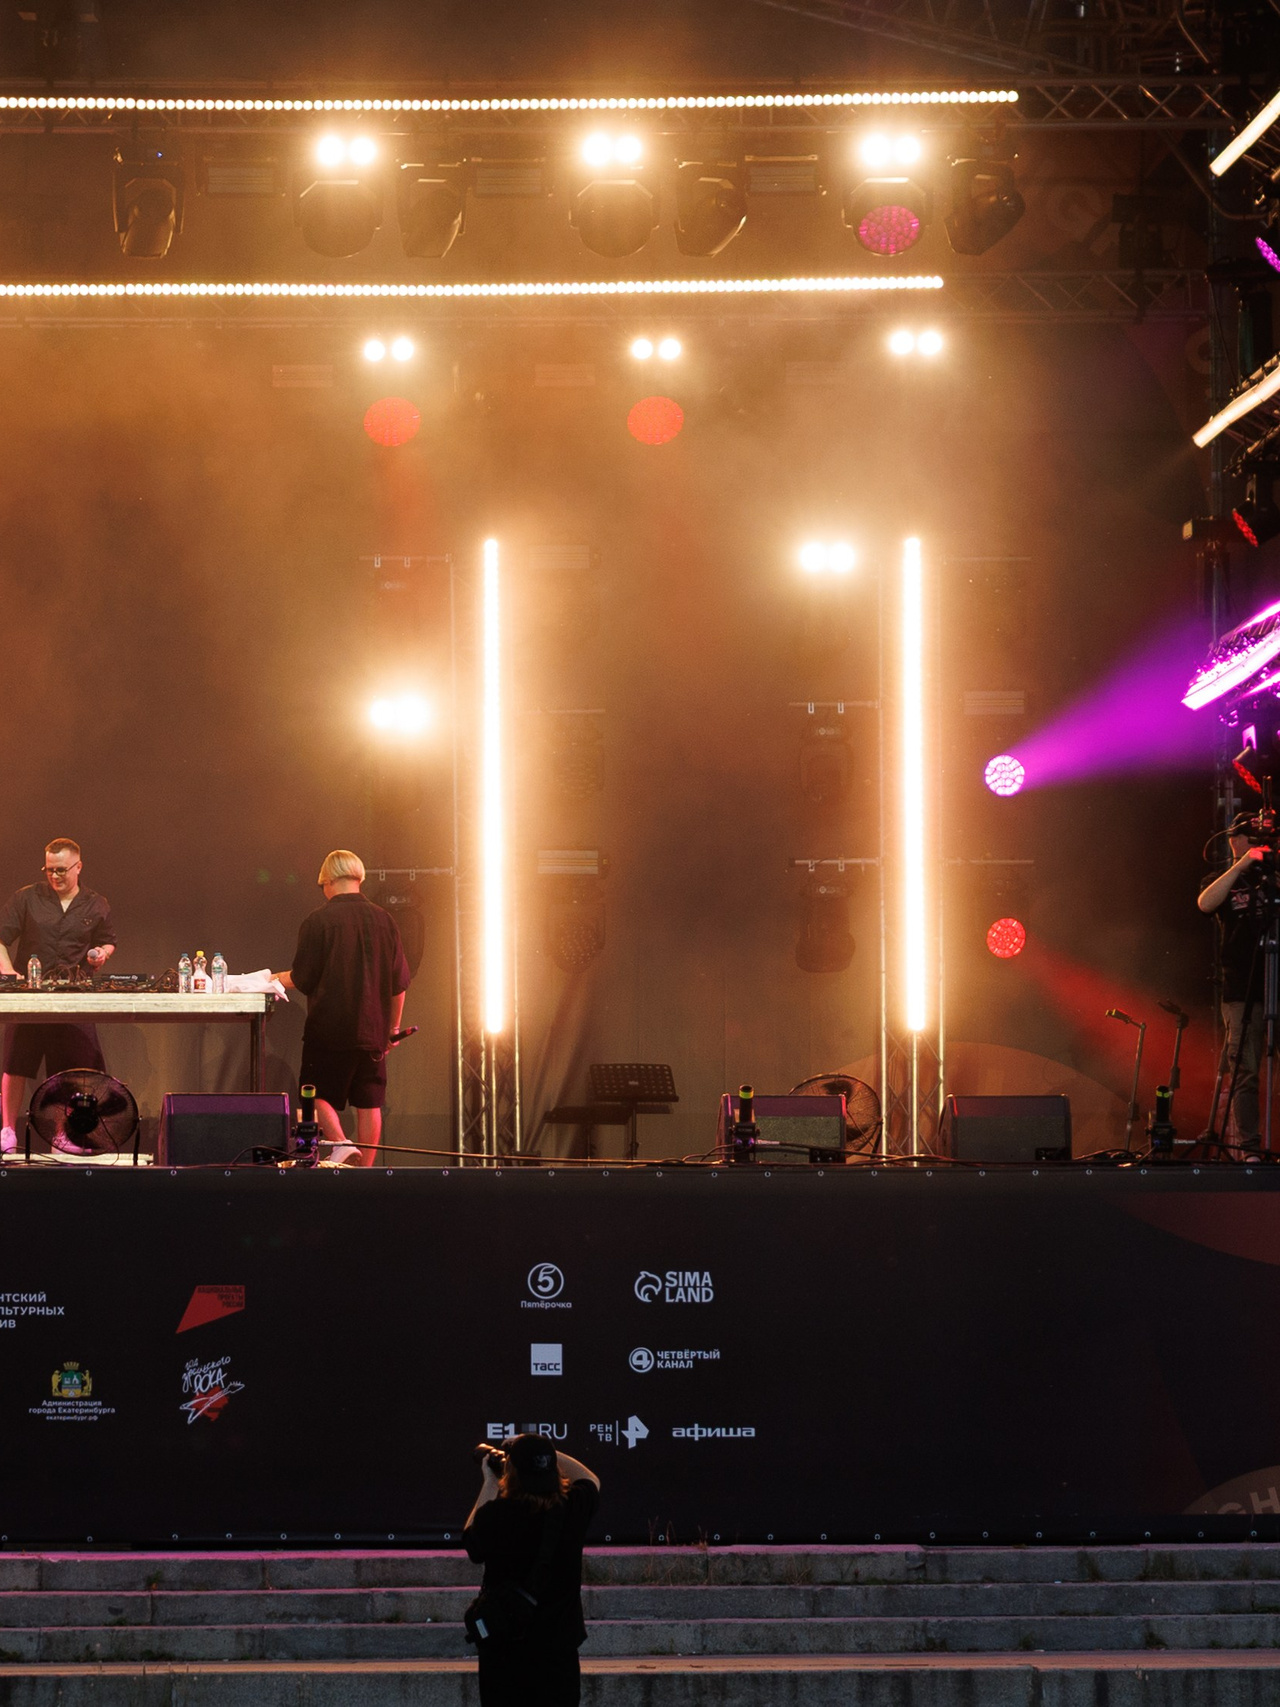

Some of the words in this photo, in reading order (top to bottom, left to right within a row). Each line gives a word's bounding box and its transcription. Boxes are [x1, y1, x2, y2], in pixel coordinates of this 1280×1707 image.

[665, 1271, 713, 1287] SIMA
[665, 1287, 714, 1303] LAND
[520, 1300, 572, 1309] Пятёрочка
[656, 1349, 720, 1359] ЧЕТВЁРТЫЙ
[656, 1360, 694, 1369] КАНАЛ
[41, 1399, 103, 1408] Администрация
[28, 1407, 57, 1415] города
[57, 1406, 116, 1415] Екатеринбурга
[589, 1423, 613, 1433] РЕН
[672, 1424, 756, 1441] афиша
[598, 1433, 613, 1442] ТВ
